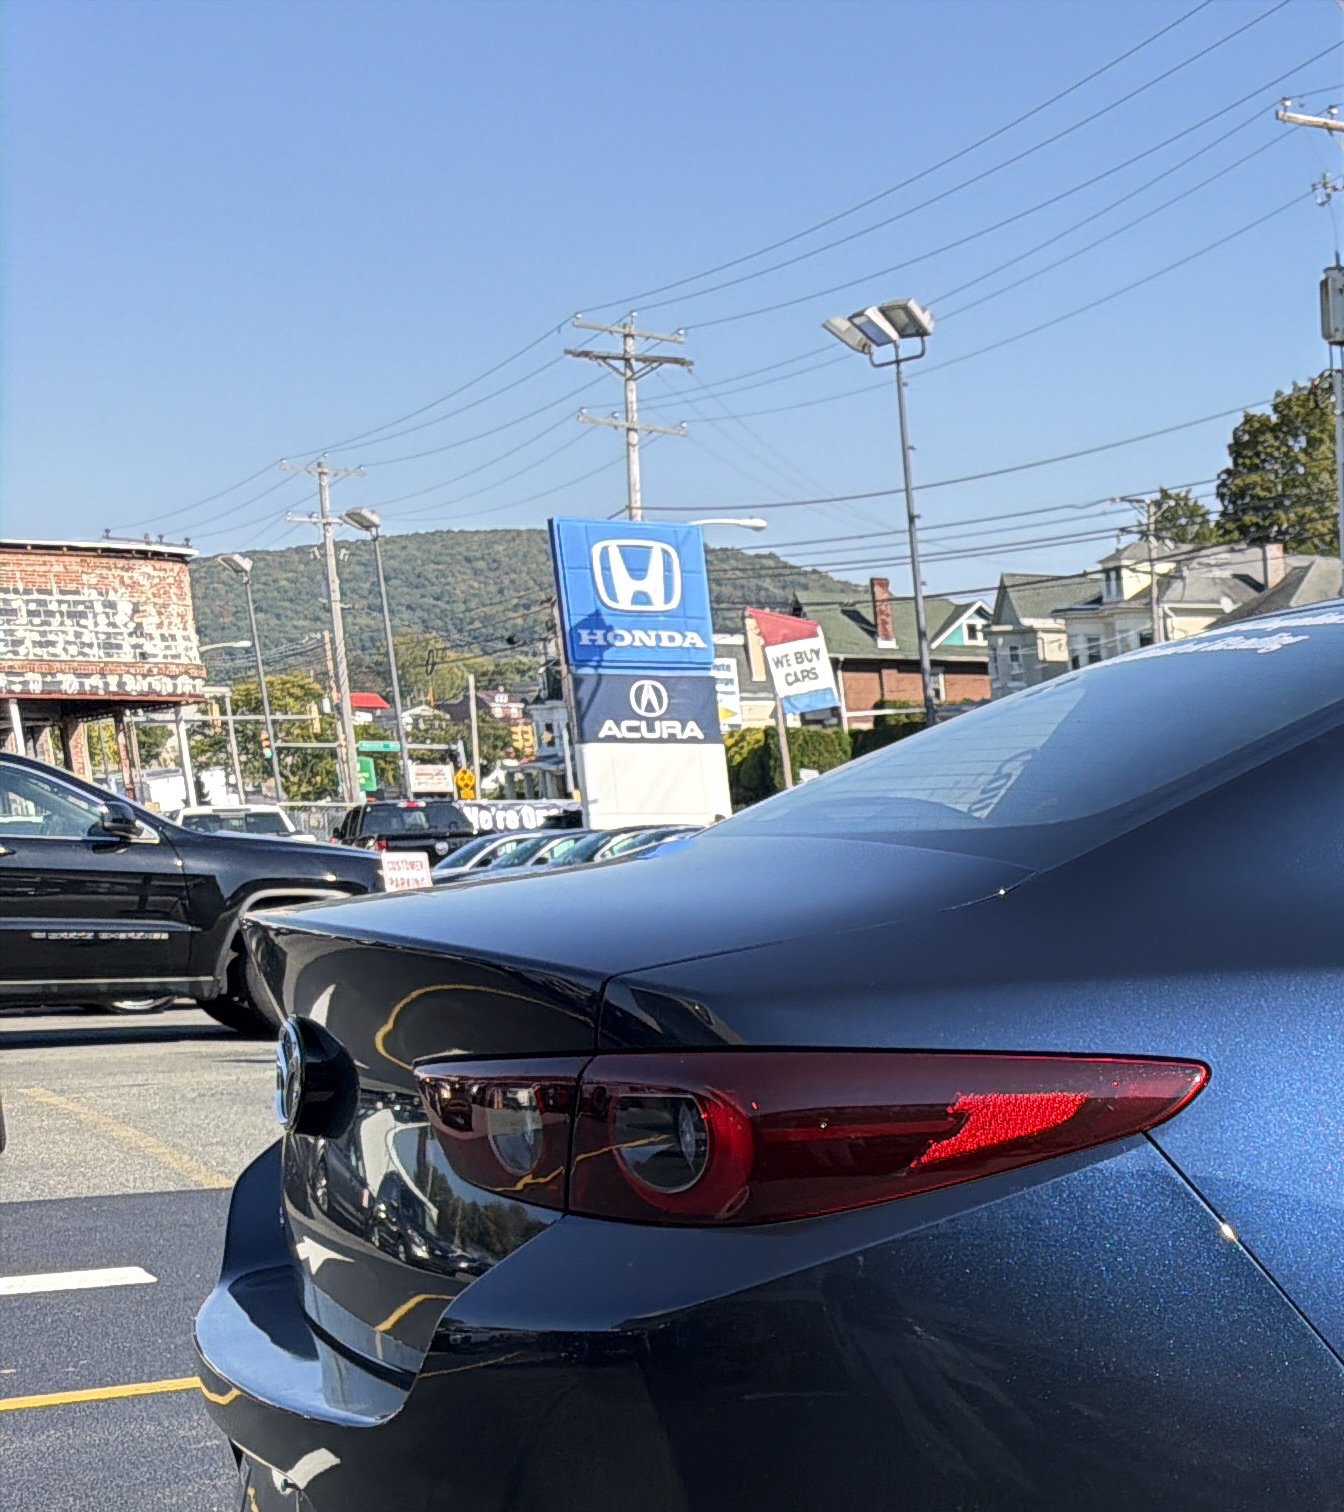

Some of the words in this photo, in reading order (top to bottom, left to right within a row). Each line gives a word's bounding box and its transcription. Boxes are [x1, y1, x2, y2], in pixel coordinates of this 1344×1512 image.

[577, 629, 708, 649] HONDA
[772, 653, 792, 669] WE
[794, 647, 820, 665] BUY
[784, 667, 819, 687] CARS
[597, 719, 705, 740] ACURA
[387, 859, 424, 871] CUSTOMER
